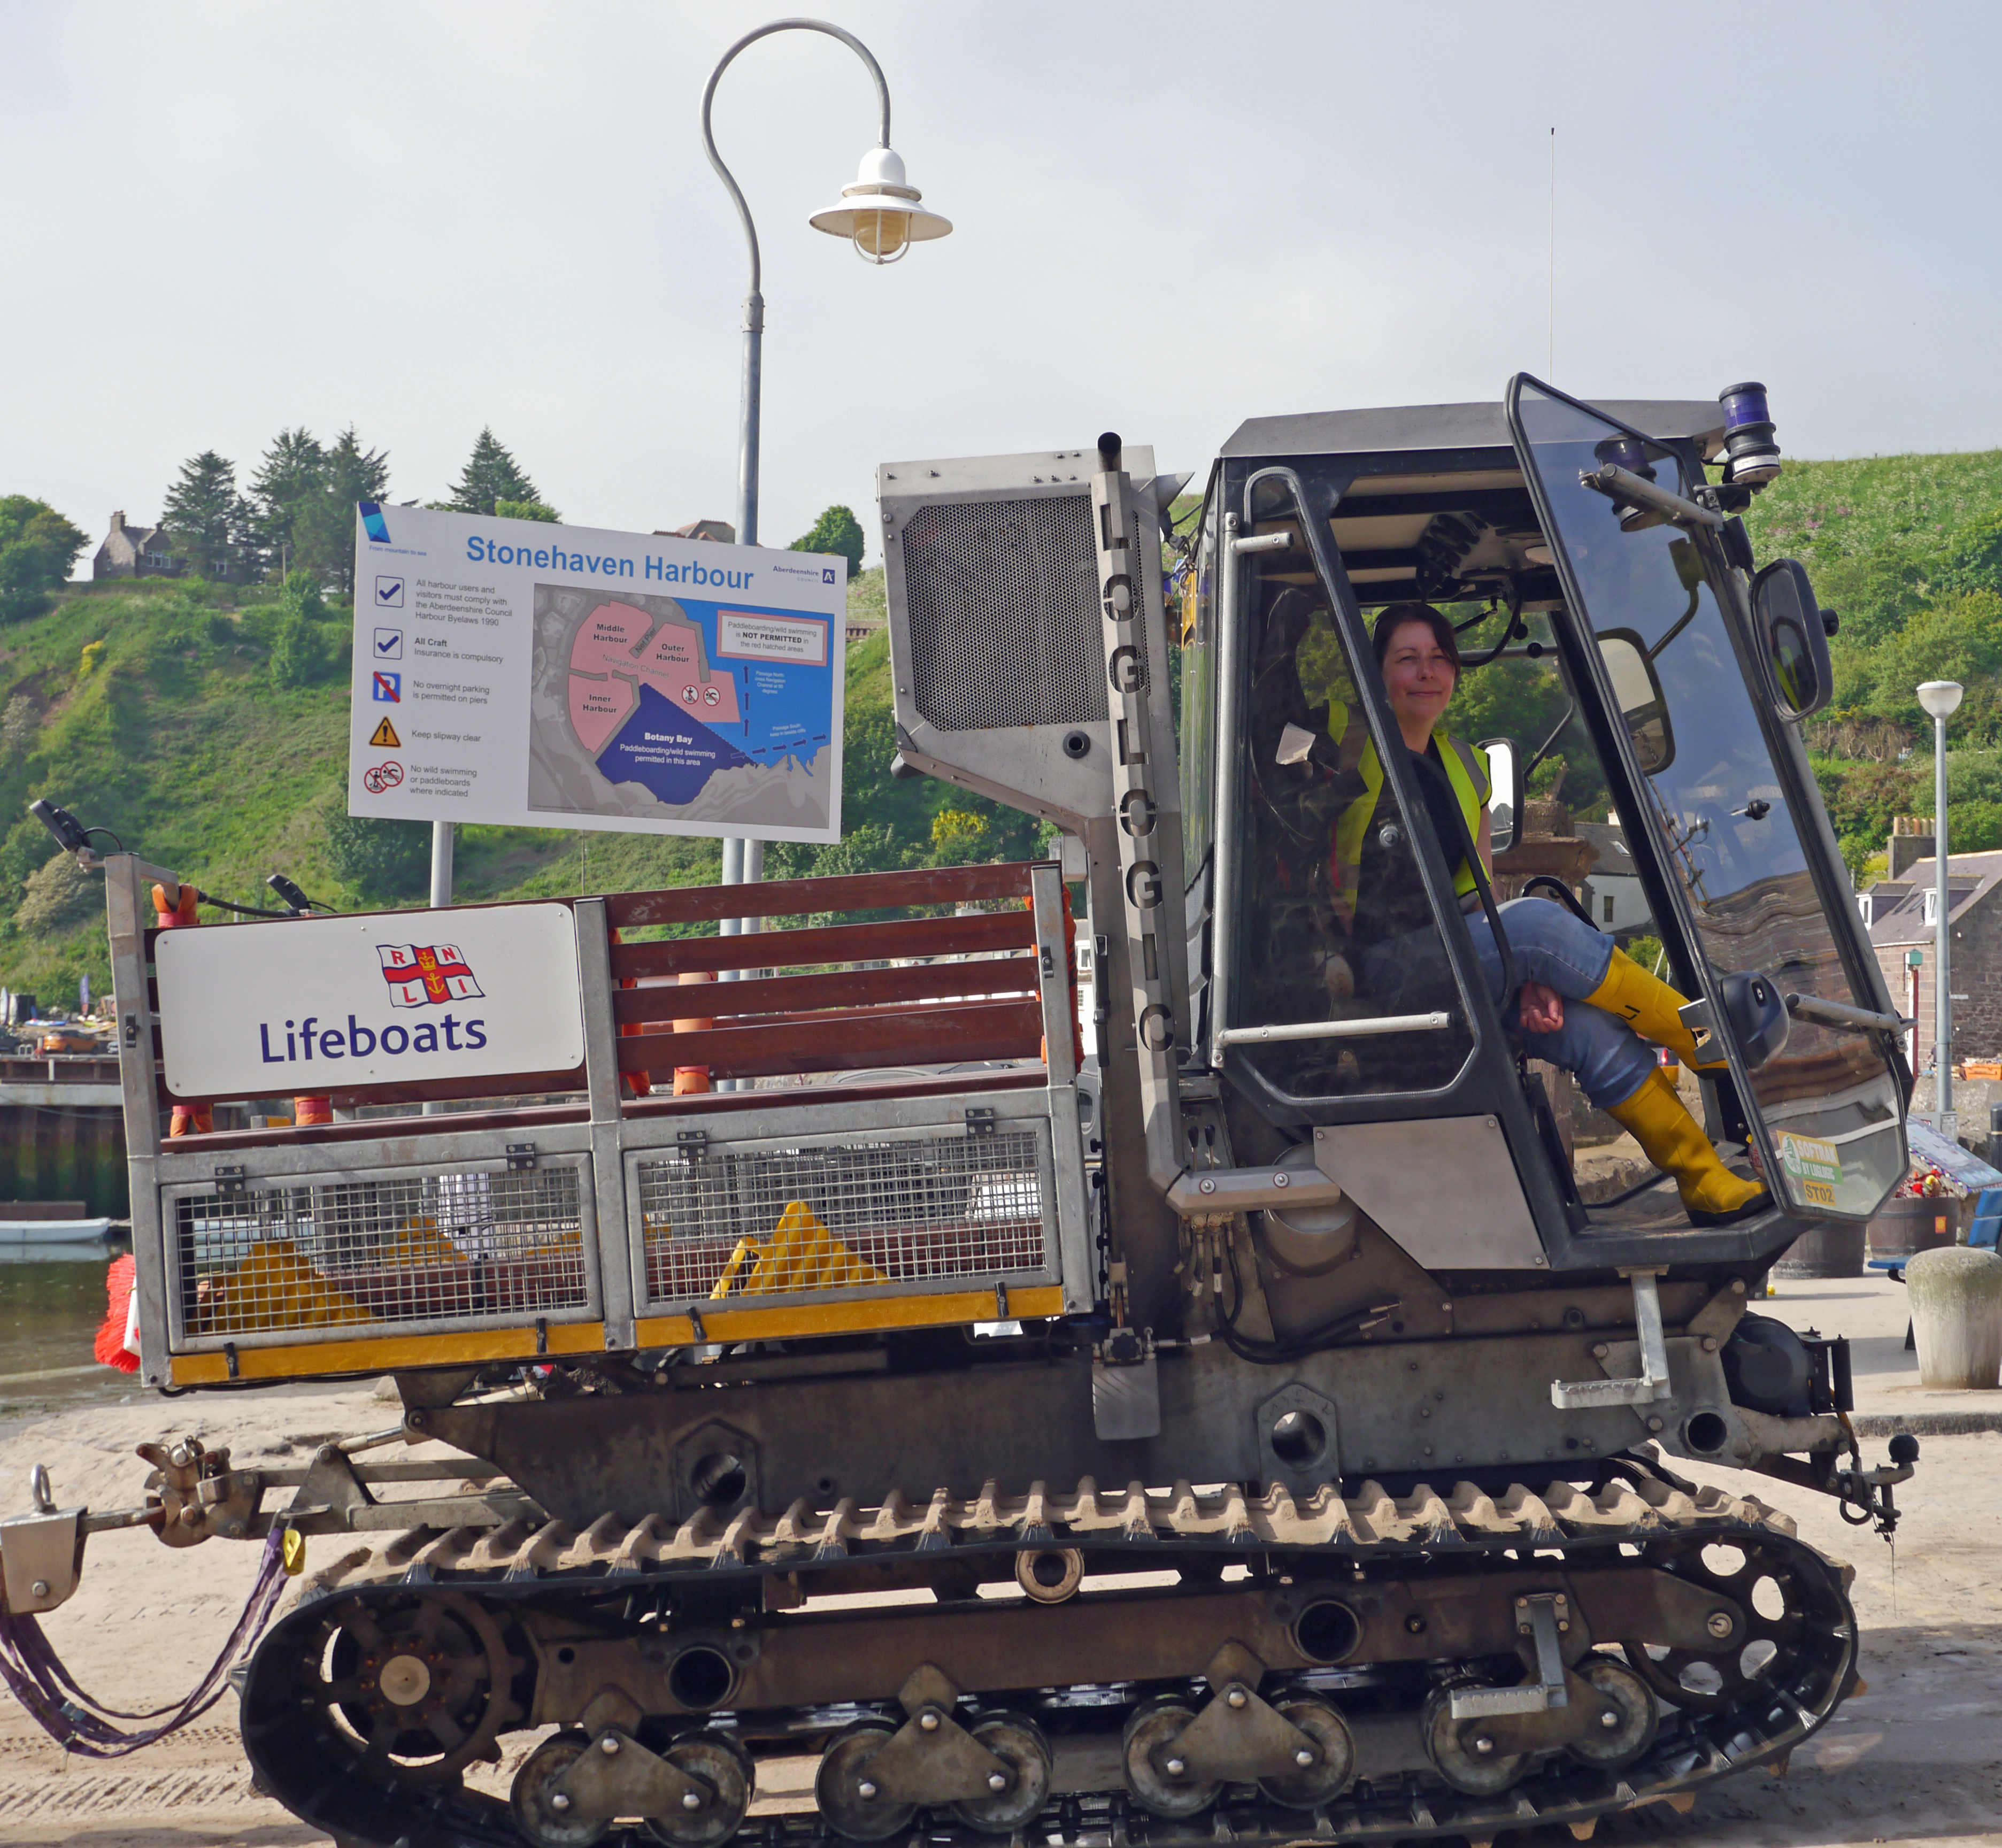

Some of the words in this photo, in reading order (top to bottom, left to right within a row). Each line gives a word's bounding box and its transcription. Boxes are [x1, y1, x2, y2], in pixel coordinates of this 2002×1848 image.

[466, 536, 635, 578] Stonehaven
[645, 555, 754, 589] Harbour
[773, 566, 819, 576] Aberdeenshire
[428, 580, 456, 590] harbour
[459, 584, 479, 592] users
[416, 591, 442, 599] visitors
[444, 594, 463, 602] must
[464, 596, 490, 605] comply
[429, 602, 483, 614] Aberdeenshire
[485, 607, 512, 617] Council
[415, 612, 445, 621] Harbour
[448, 614, 479, 625] Byelaws
[481, 618, 499, 626] 1990
[597, 623, 625, 633] Middle
[728, 621, 787, 633] Paddleboarding/wild
[788, 628, 817, 637] swimming
[428, 638, 447, 647] Craft
[594, 634, 627, 643] Harbour
[635, 642, 646, 653] Net
[645, 628, 657, 641] Pier
[760, 633, 802, 643] PERMITTED
[661, 644, 685, 652] Outer
[763, 643, 786, 651] hatched
[414, 648, 451, 658] Insurance
[461, 653, 503, 664] compulsory
[656, 653, 689, 663] Harbour
[603, 654, 638, 670] Navigation
[641, 665, 669, 679] Channel
[426, 682, 460, 692] overnight
[463, 686, 489, 695] parking
[421, 692, 456, 702] permitted
[469, 696, 487, 704] piers
[583, 704, 617, 713] Harbour
[412, 730, 431, 740] Keep
[434, 732, 460, 743] slipway
[463, 734, 481, 742] clear
[645, 732, 674, 743] Botany
[676, 735, 692, 745] Bay
[620, 744, 683, 756] Paddleboarding/wild
[684, 749, 715, 759] swimming
[635, 755, 665, 763] permitted
[424, 766, 438, 774] wild
[440, 768, 477, 777] swimming
[420, 777, 470, 787] paddleboards
[435, 788, 468, 797] indicated
[260, 1014, 487, 1063] Lifeboats
[1797, 1139, 1838, 1164] SOFTRAK
[1801, 1162, 1810, 1175] BY
[1810, 1164, 1835, 1181] LOGLOGIC
[1805, 1184, 1834, 1203] ST02
